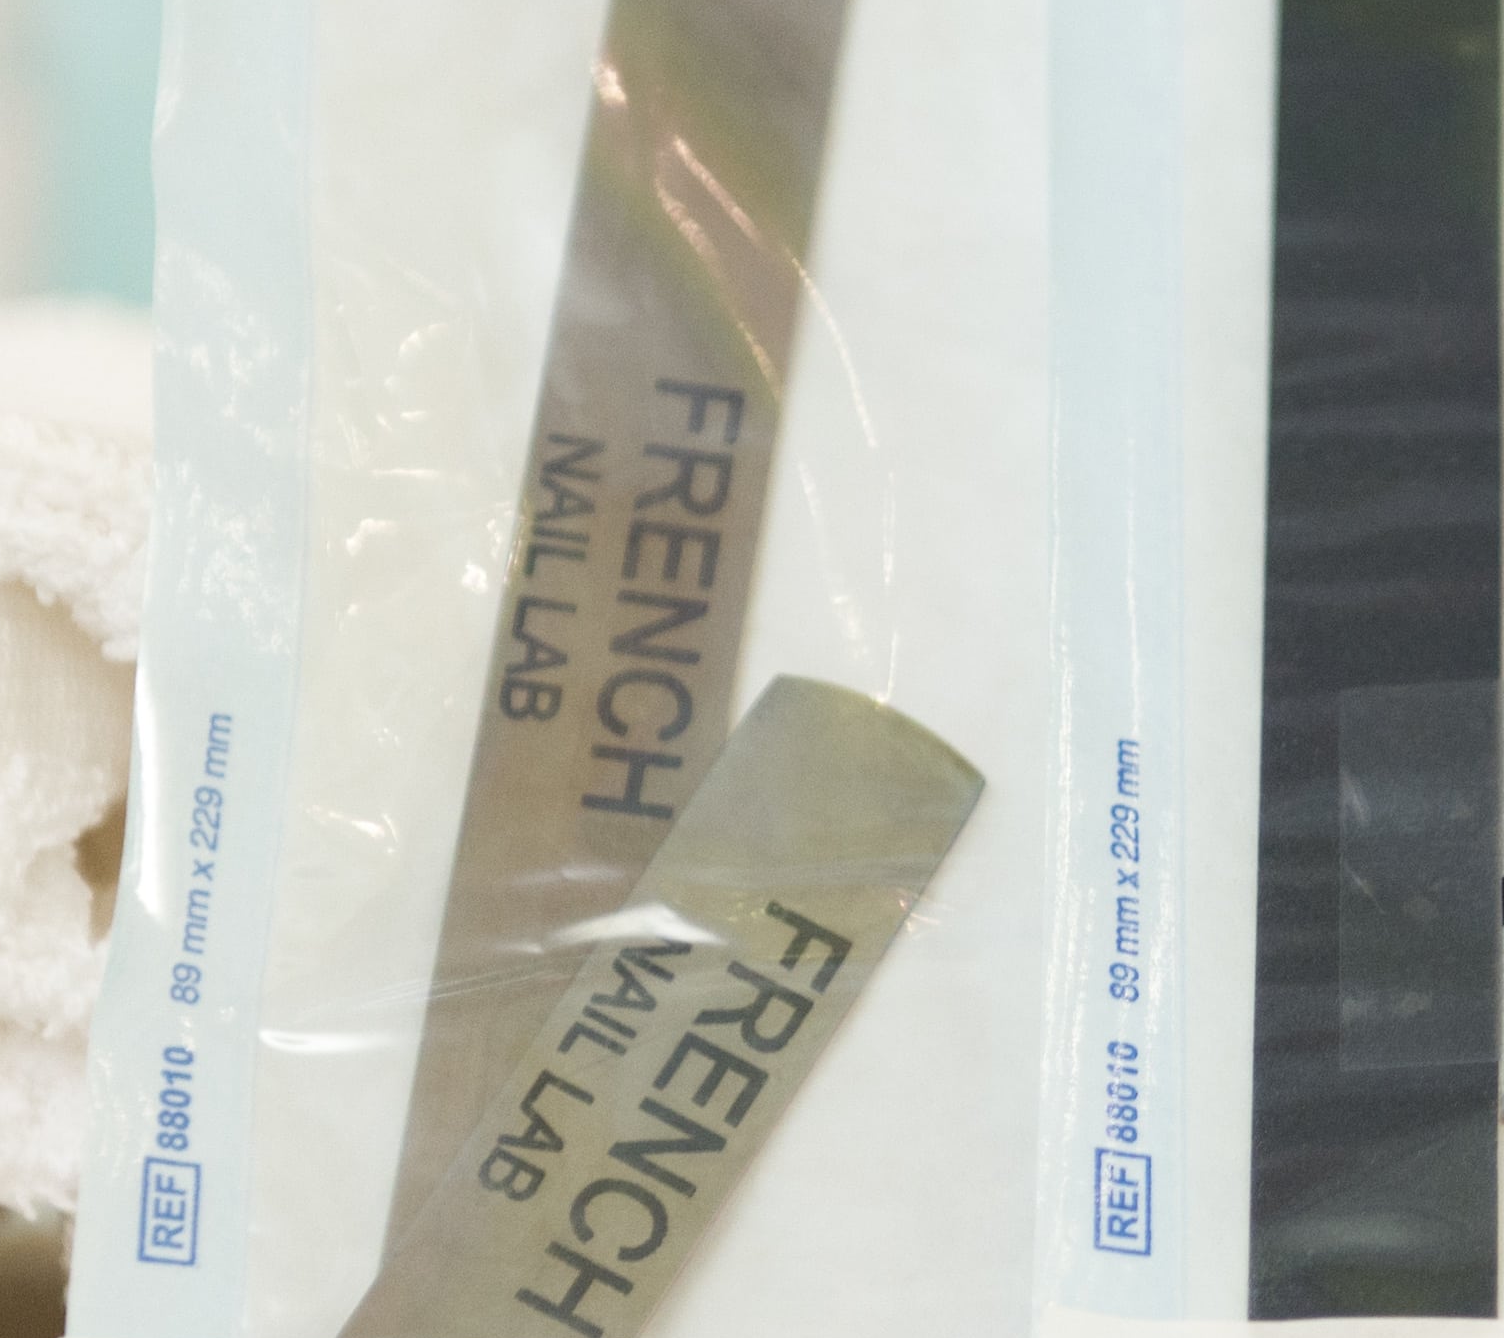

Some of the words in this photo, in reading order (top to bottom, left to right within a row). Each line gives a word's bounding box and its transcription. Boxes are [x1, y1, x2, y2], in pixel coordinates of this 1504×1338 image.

[522, 434, 606, 577] NAIL
[581, 377, 744, 821] FRENCH
[499, 593, 580, 723] LAB
[205, 713, 232, 779] mm
[1116, 739, 1140, 797] mm
[188, 786, 222, 851] 229
[1110, 804, 1140, 863] 229
[191, 860, 214, 881] x
[1117, 871, 1139, 888] x
[182, 889, 211, 955] mm
[1115, 897, 1140, 956] mm
[170, 963, 201, 1005] 89
[556, 938, 692, 1057] NAIL
[156, 1045, 194, 1152] 88010
[477, 1069, 595, 1206] LAB
[152, 1175, 187, 1249] REF
[1108, 1165, 1139, 1239] REF
